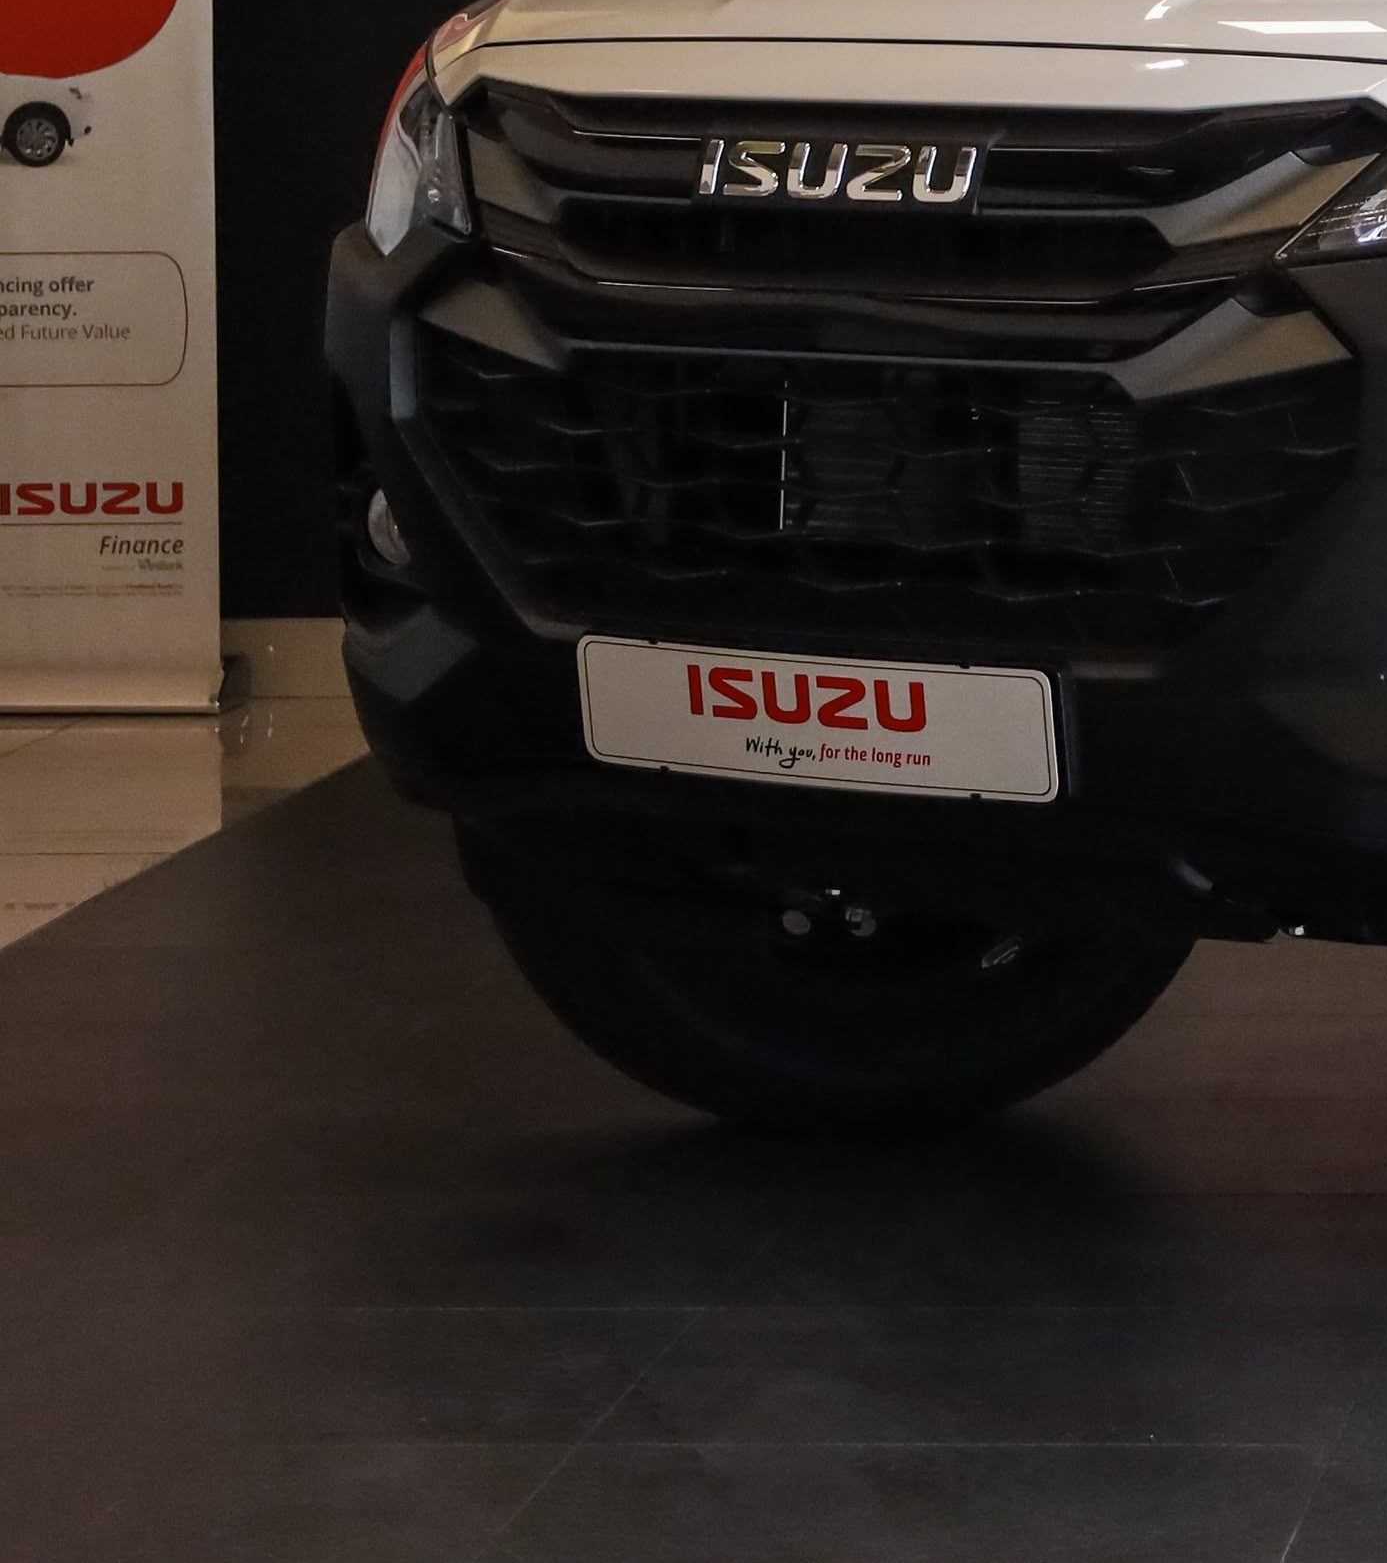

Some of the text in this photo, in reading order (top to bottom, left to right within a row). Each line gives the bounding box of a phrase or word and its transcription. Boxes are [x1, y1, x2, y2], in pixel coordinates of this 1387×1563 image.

[699, 139, 977, 203] ISUZU
[49, 276, 95, 293] offer
[21, 324, 78, 340] Future
[82, 324, 131, 340] Value
[0, 482, 184, 516] ISUZU
[100, 535, 184, 556] Finance
[687, 664, 927, 733] ISUZU
[745, 736, 931, 769] With you, for the long run
